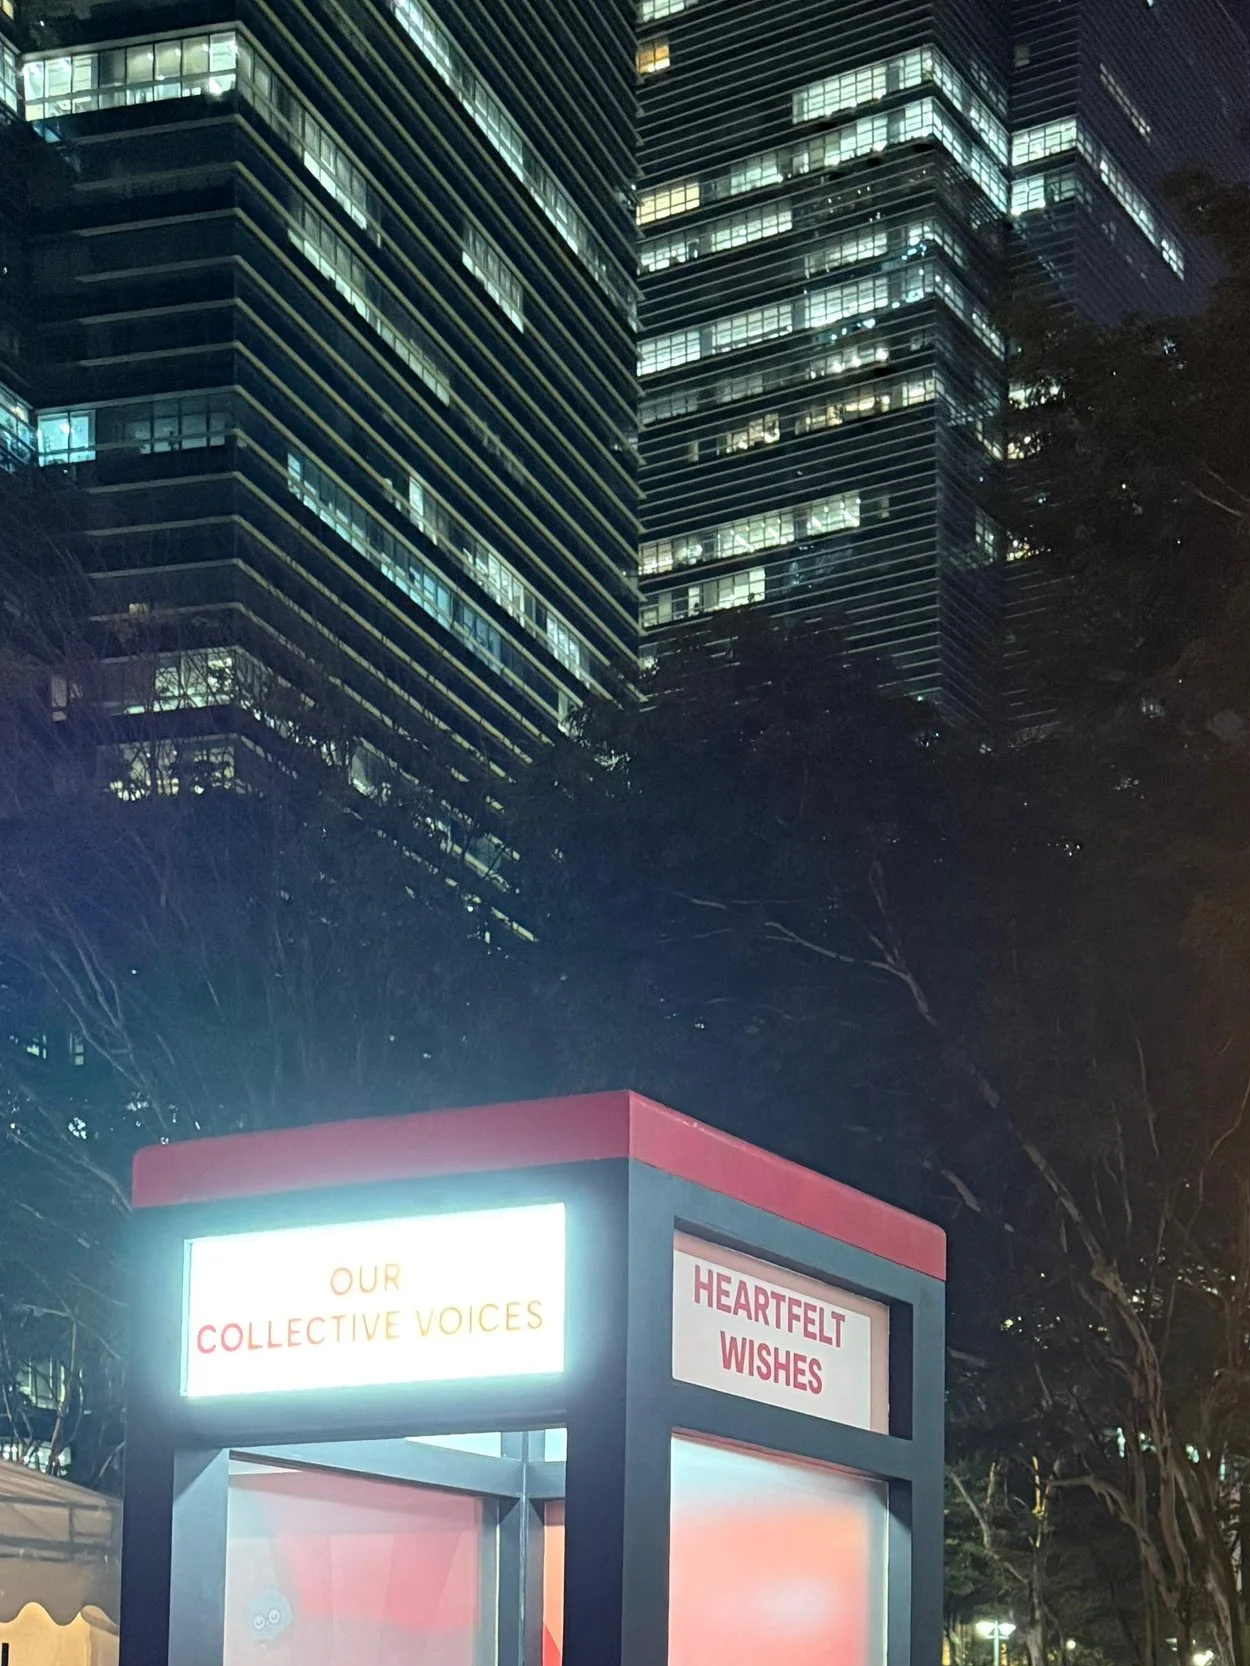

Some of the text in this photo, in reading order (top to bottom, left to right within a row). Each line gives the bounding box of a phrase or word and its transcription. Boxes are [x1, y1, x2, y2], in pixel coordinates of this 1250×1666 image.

[329, 1262, 401, 1297] OUR
[692, 1262, 847, 1349] HEARTFELT
[196, 1299, 544, 1356] COLLECTIVE VOICES
[718, 1329, 824, 1396] WISHES
